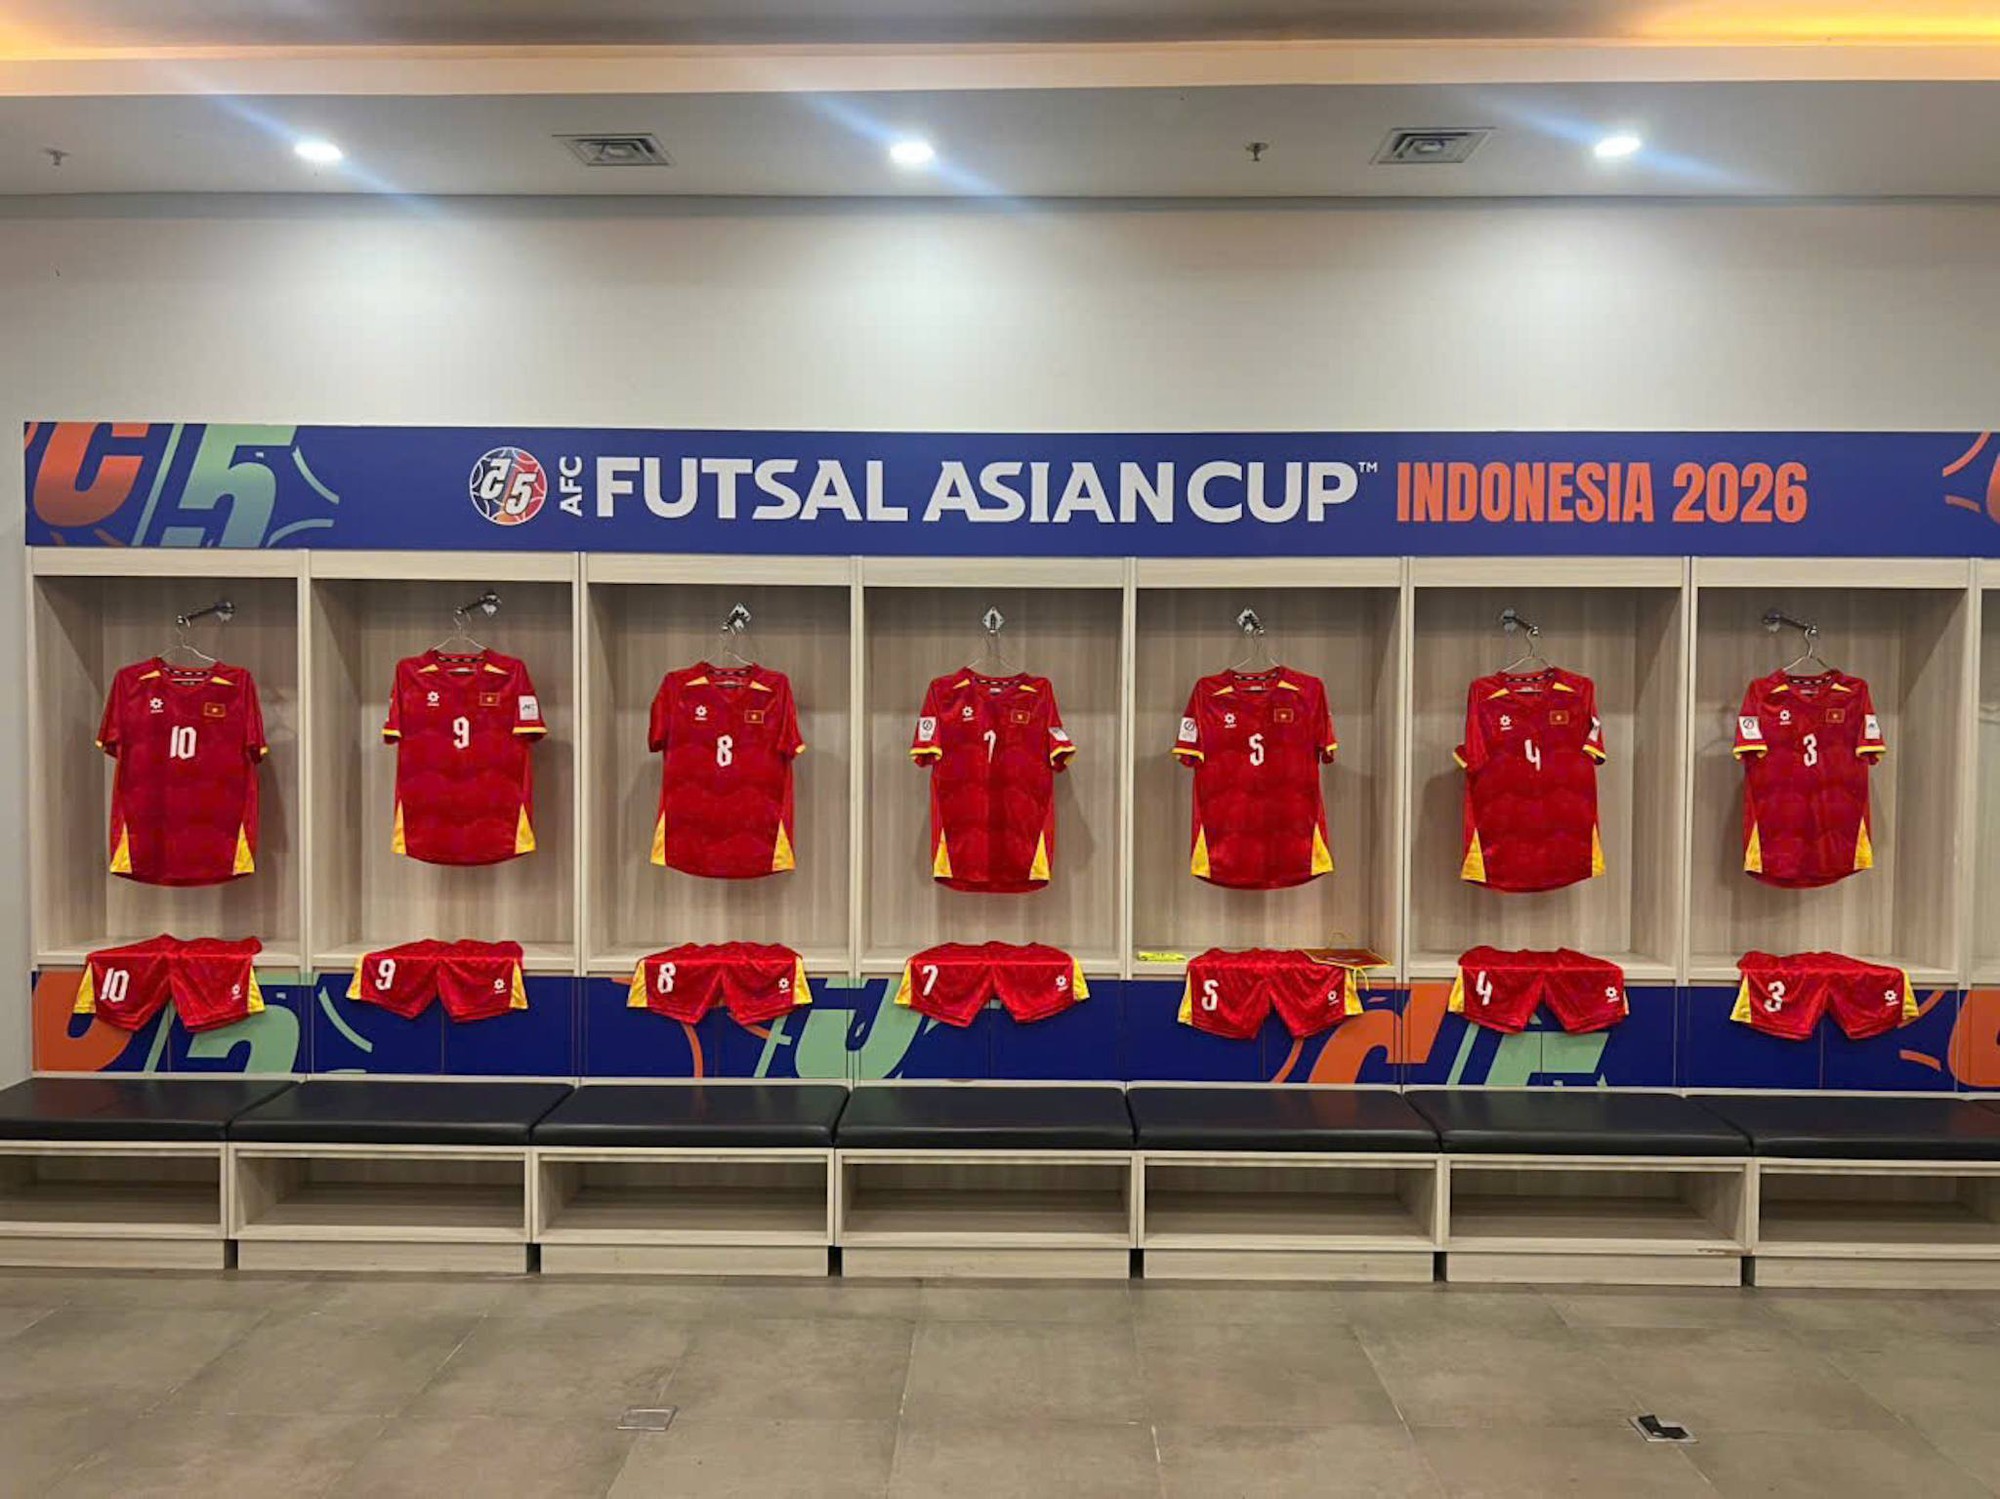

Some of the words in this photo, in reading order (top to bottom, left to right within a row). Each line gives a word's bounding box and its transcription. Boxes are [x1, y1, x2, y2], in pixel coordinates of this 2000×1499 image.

[559, 456, 582, 517] AFC
[597, 456, 908, 521] FUTSAL
[923, 460, 1173, 523] ASIAN
[1398, 463, 1654, 523] INDONESIA
[1674, 463, 1808, 523] 2026
[169, 725, 197, 760] 10
[453, 716, 470, 750] 9
[1248, 732, 1265, 767] 5
[1802, 733, 1818, 767] 3
[716, 734, 733, 768] 8
[1524, 739, 1542, 772] 4
[100, 967, 130, 1003] 10
[375, 958, 397, 991] 9
[657, 961, 677, 994] 8
[922, 964, 939, 996] 7
[1475, 970, 1493, 1006] 4
[1201, 979, 1219, 1012] 5
[1763, 980, 1786, 1013] 3
